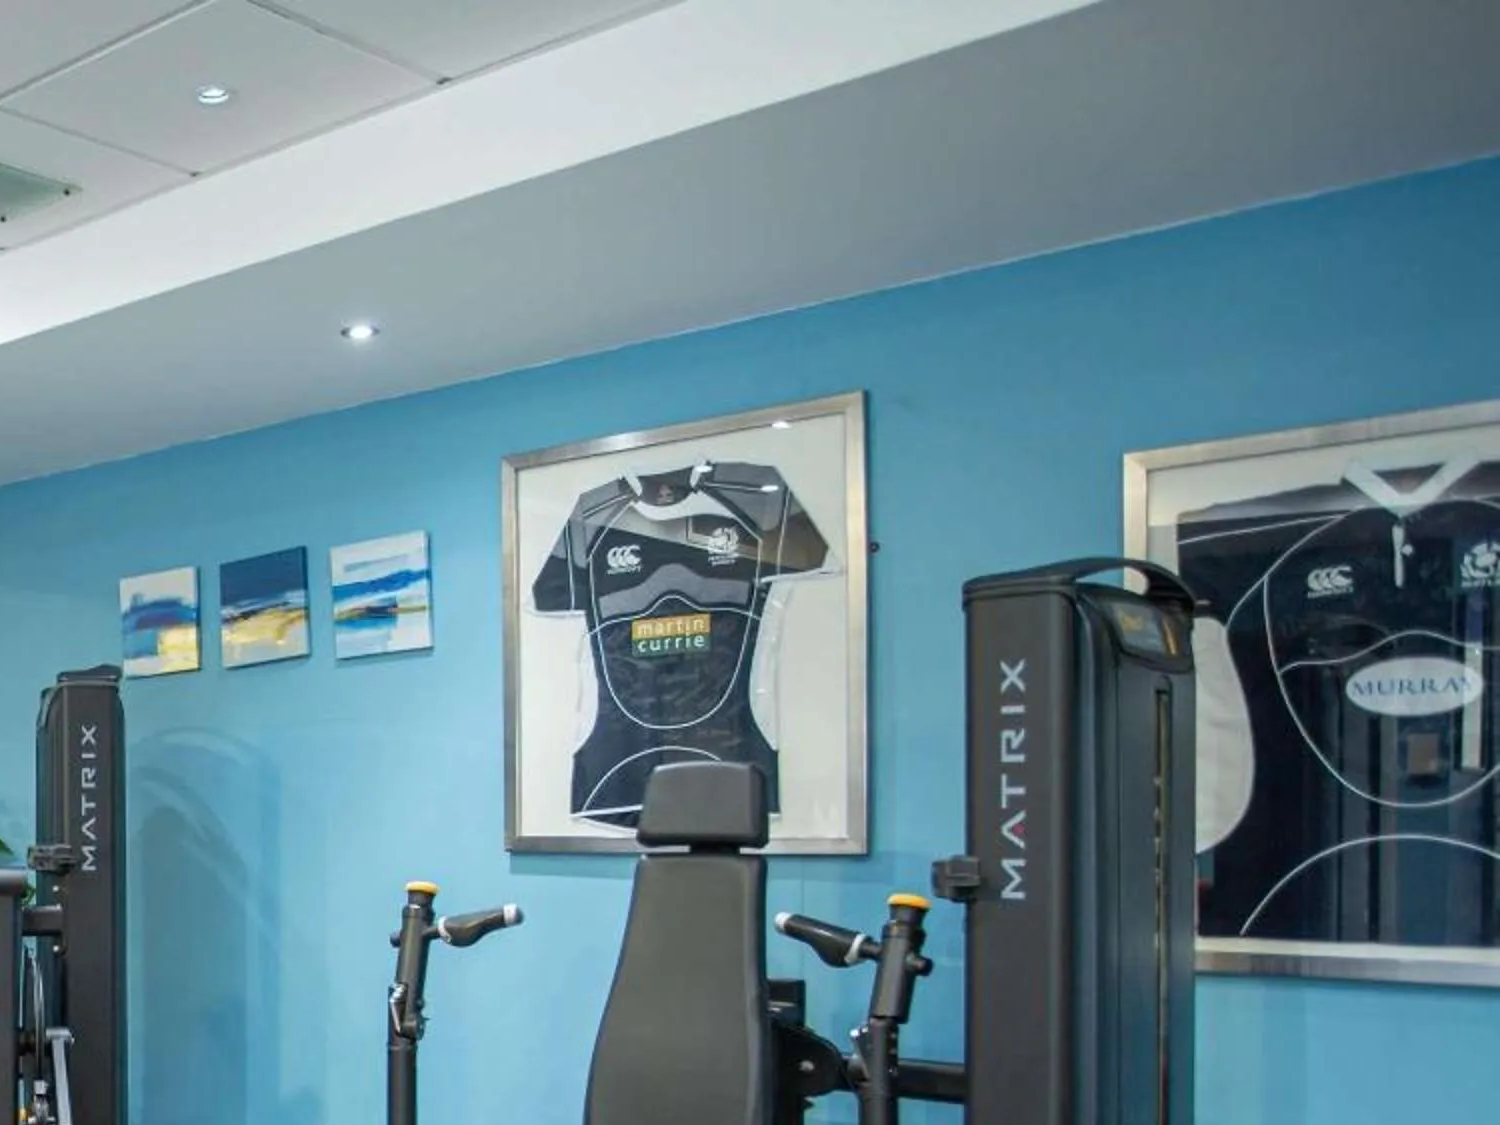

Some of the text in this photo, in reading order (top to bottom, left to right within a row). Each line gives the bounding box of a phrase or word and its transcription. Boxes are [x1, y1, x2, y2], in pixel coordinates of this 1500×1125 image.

[637, 617, 706, 636] martin
[637, 632, 706, 653] currie
[1351, 675, 1473, 697] MURRAY
[999, 658, 1027, 900] MATRIX
[80, 724, 97, 872] MATRIX
